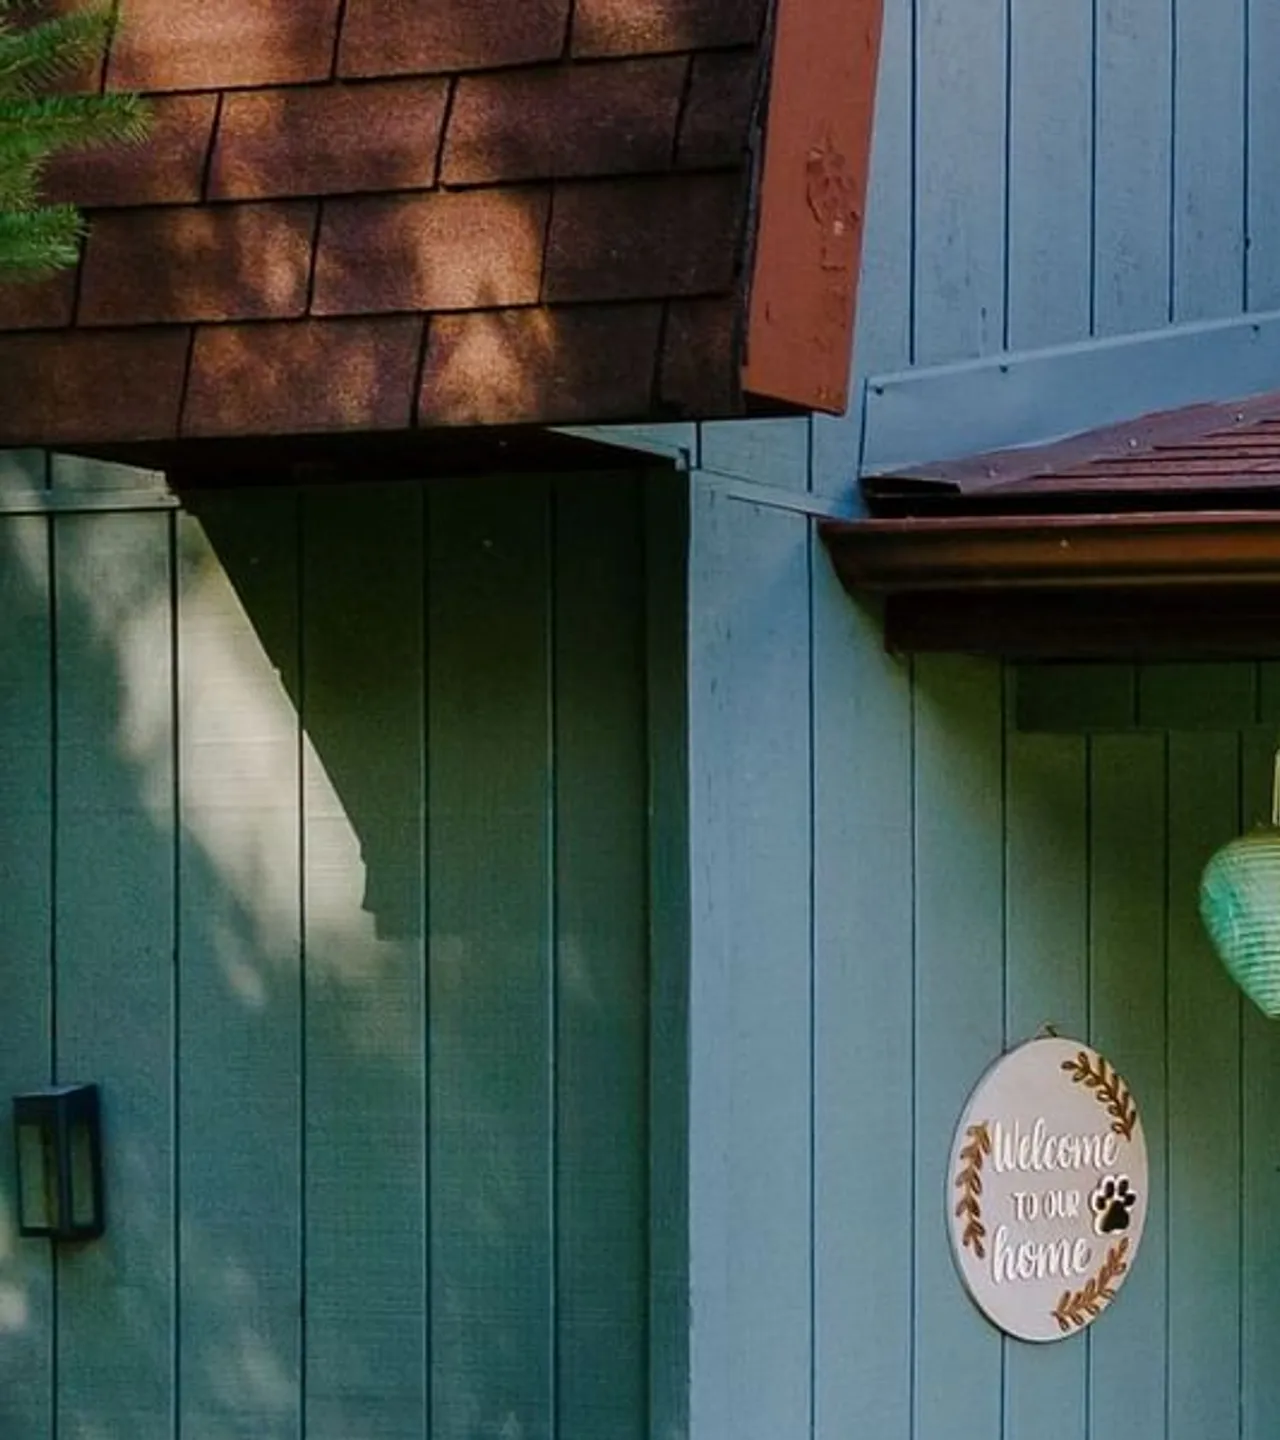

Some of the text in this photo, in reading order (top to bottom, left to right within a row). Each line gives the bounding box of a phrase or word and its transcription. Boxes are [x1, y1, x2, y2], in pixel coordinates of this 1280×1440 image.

[991, 1117, 1120, 1173] Welcome
[1012, 1189, 1080, 1220] TO OUR
[992, 1226, 1092, 1284] home
